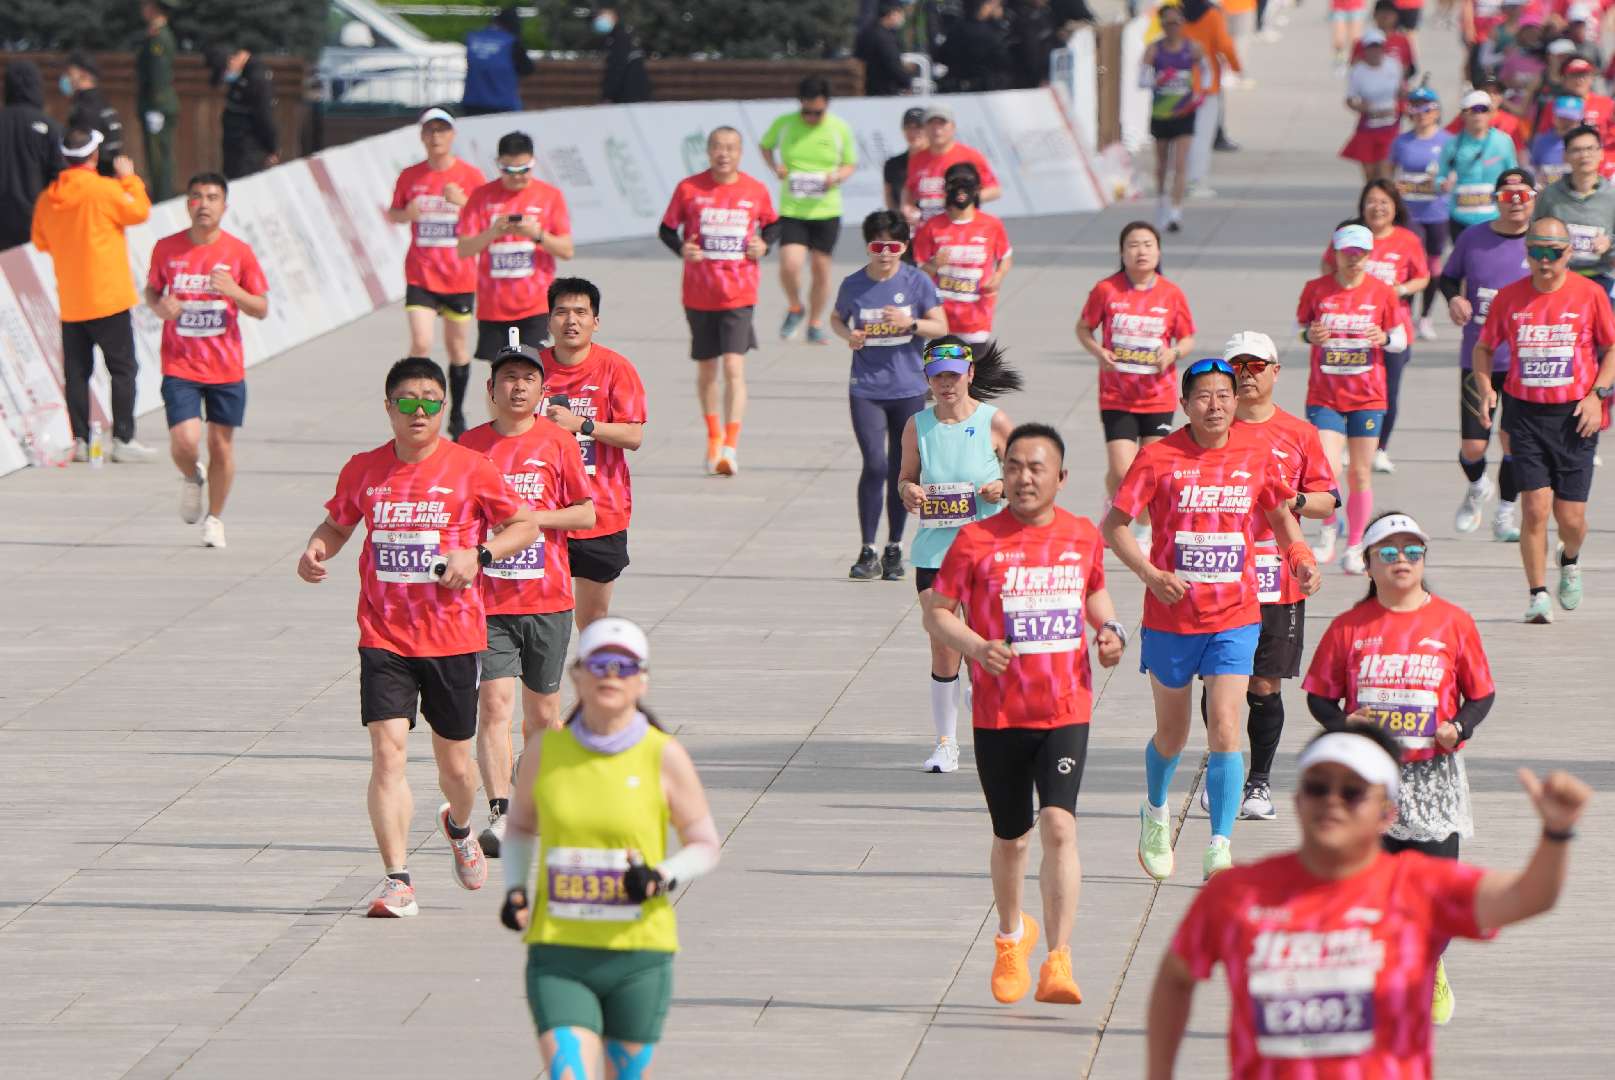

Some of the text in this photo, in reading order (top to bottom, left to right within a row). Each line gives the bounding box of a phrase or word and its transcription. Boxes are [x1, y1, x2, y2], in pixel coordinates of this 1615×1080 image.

[180, 313, 223, 327] E2376
[1517, 324, 1552, 341] 北京
[1326, 352, 1367, 364] E7928
[1524, 361, 1568, 375] E2077
[571, 397, 592, 407] BEI
[514, 473, 541, 483] BEI
[1178, 485, 1223, 507] 北京
[1222, 486, 1248, 496] BEI
[416, 501, 445, 512] BEI
[923, 499, 970, 515] E7948
[1219, 496, 1252, 507] JING
[372, 501, 416, 523] 北京
[413, 512, 451, 523] JING
[379, 550, 433, 567] E1616
[1182, 550, 1238, 568] E2970
[1002, 566, 1053, 591] 北京
[1013, 616, 1077, 637] E1742
[1357, 654, 1408, 679] 北京
[1407, 654, 1439, 667] BEI
[1405, 666, 1444, 680] JING
